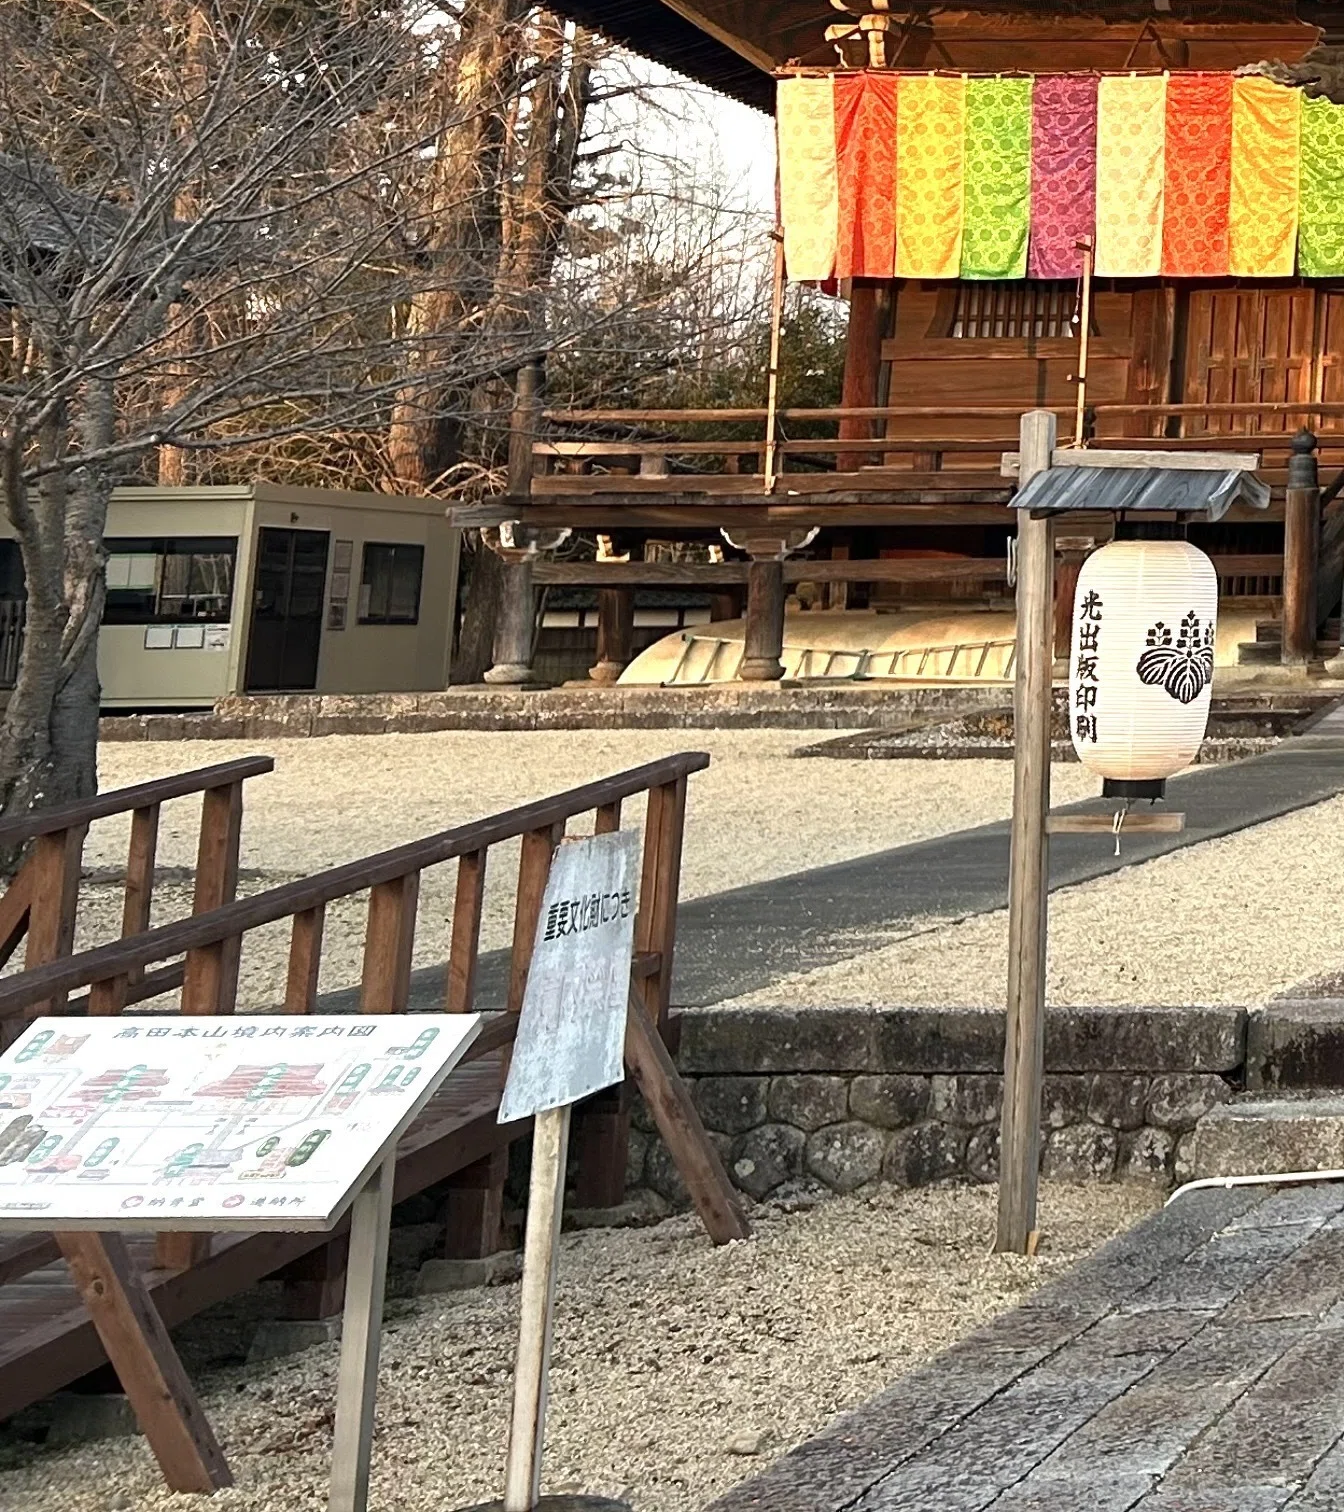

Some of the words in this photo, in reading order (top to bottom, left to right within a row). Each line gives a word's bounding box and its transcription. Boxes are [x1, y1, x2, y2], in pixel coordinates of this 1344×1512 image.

[1075, 589, 1104, 743] 光出版印刷
[543, 890, 632, 942] 重要文化財につき
[112, 1025, 378, 1040] 高田本山境内案内図
